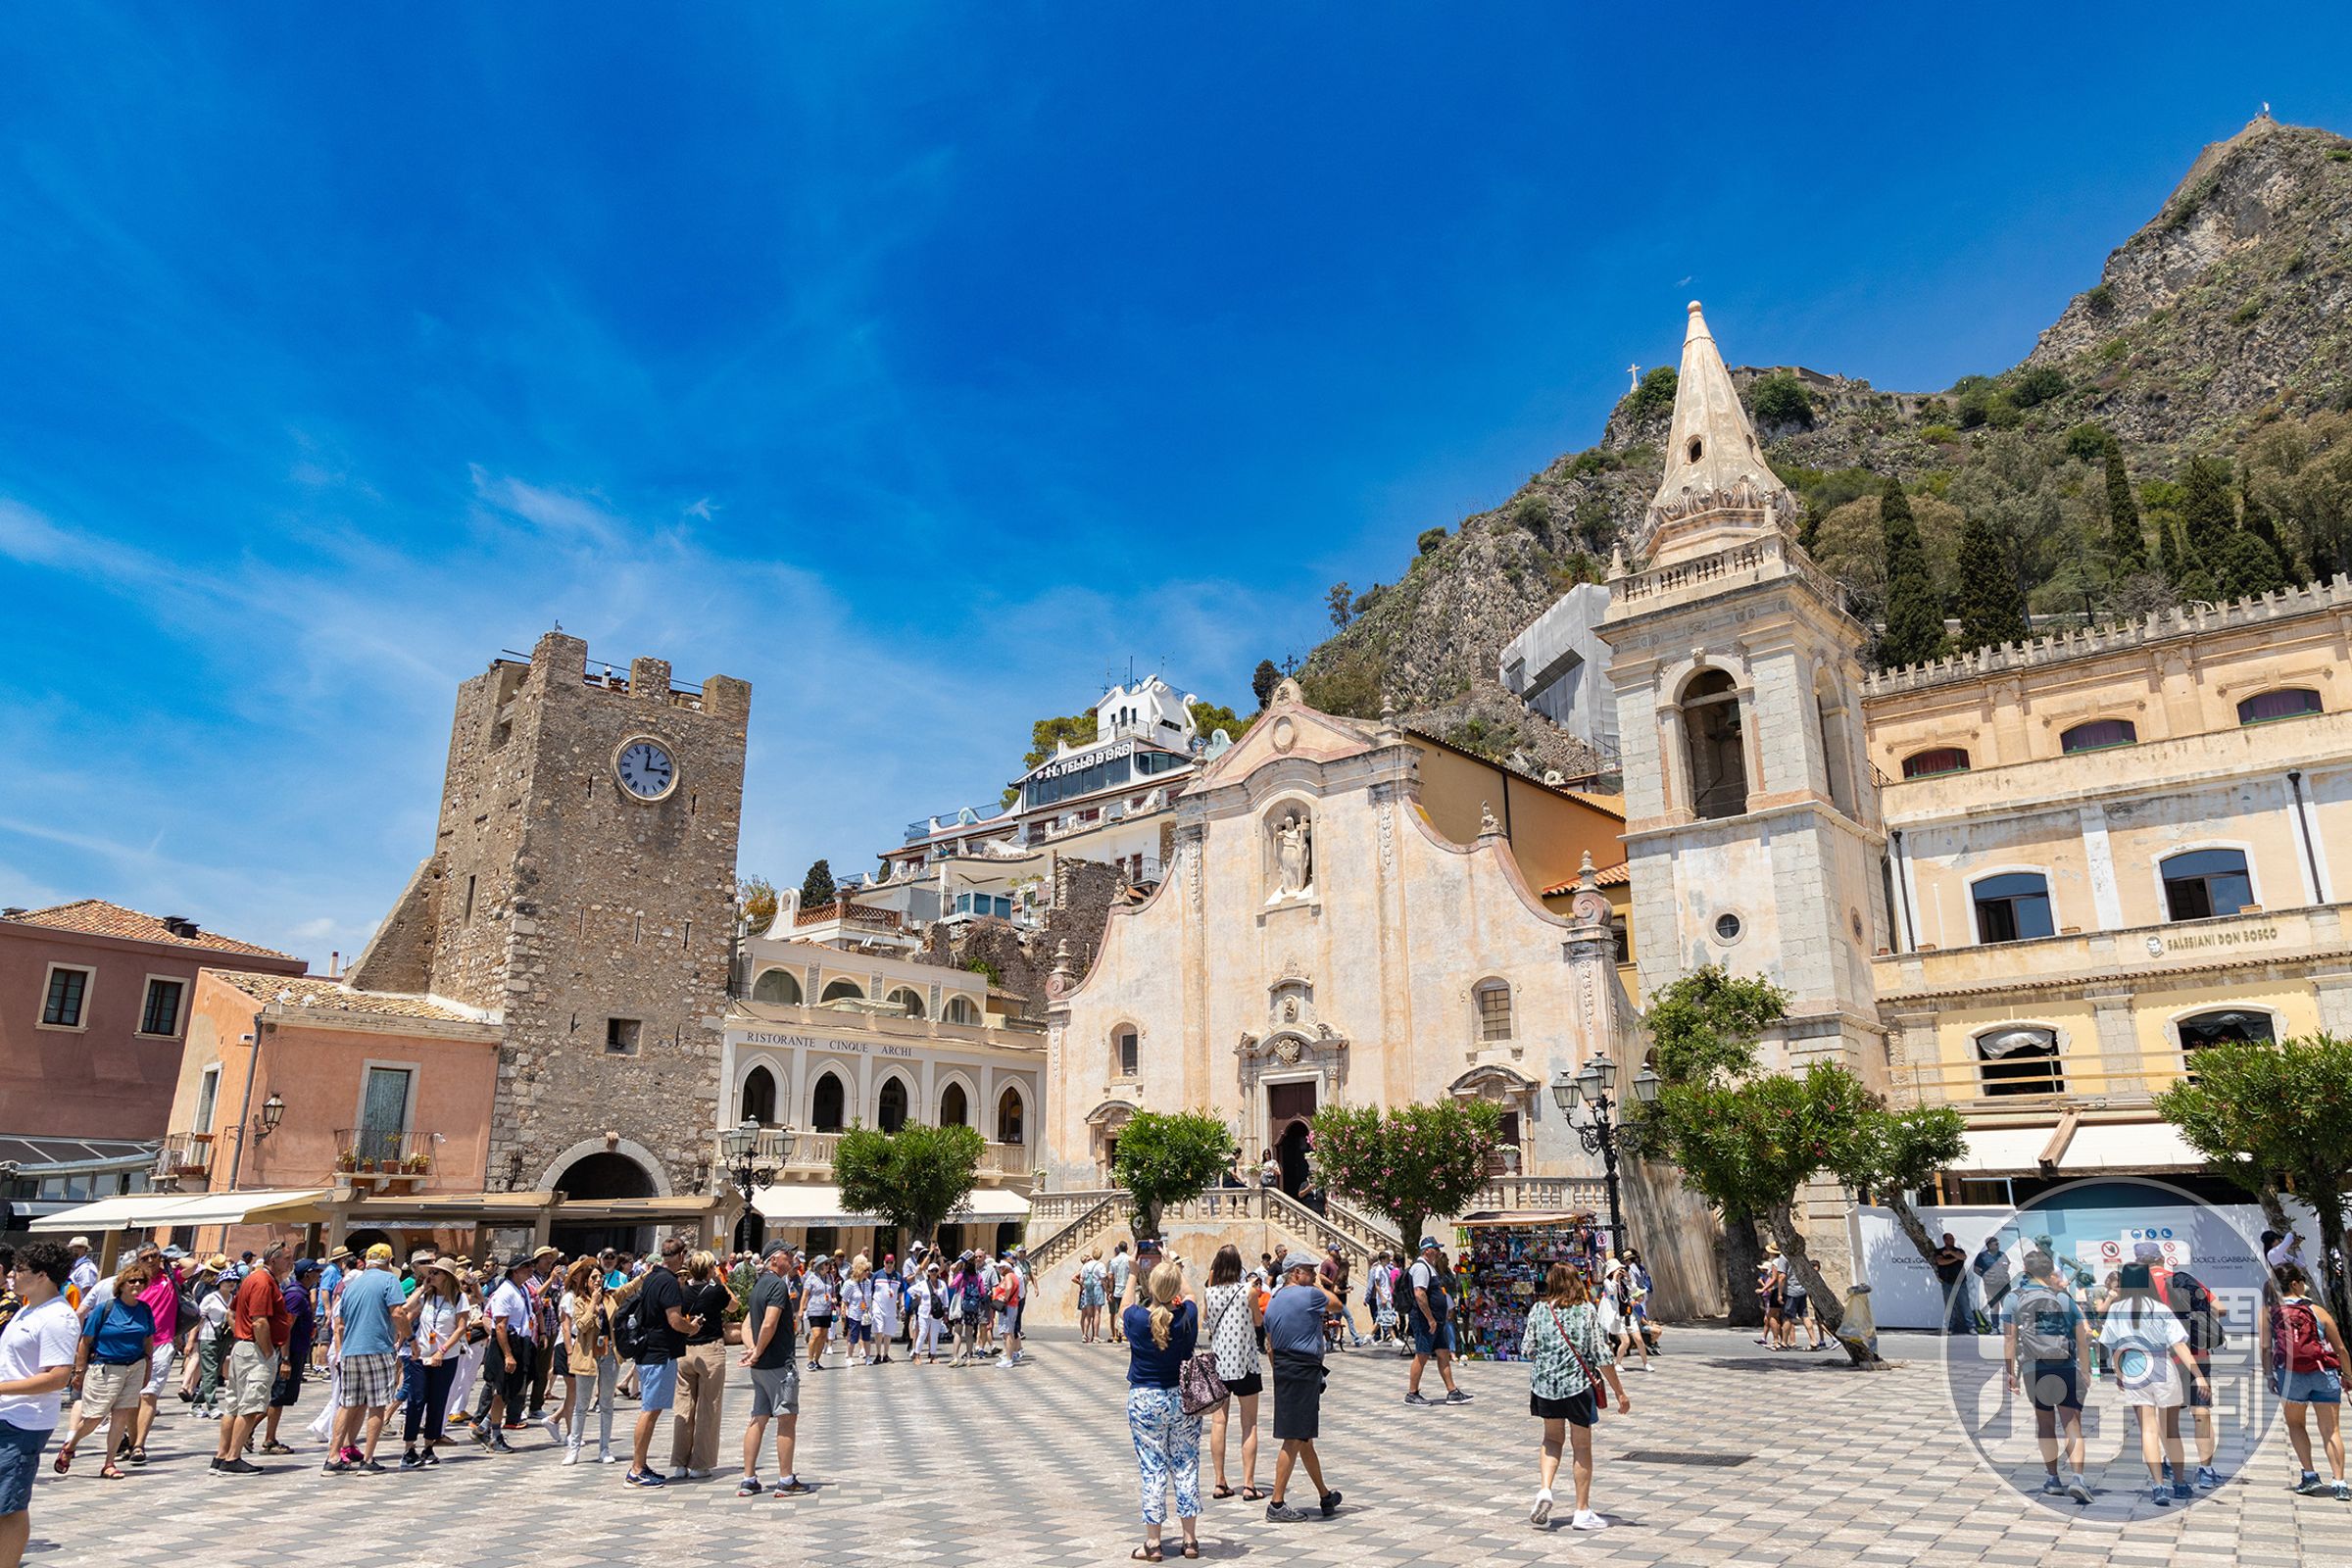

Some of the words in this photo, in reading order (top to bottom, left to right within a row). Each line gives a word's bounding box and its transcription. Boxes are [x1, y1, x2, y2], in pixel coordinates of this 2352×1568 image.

[1060, 755, 1095, 775] VELLO
[2168, 934, 2215, 952] SALESIANI
[2218, 932, 2241, 946] DON
[2243, 927, 2278, 942] BOSCO
[747, 1032, 815, 1048] RISTORANTE
[829, 1041, 868, 1053] CINQUE
[881, 1046, 911, 1056] ARCHI
